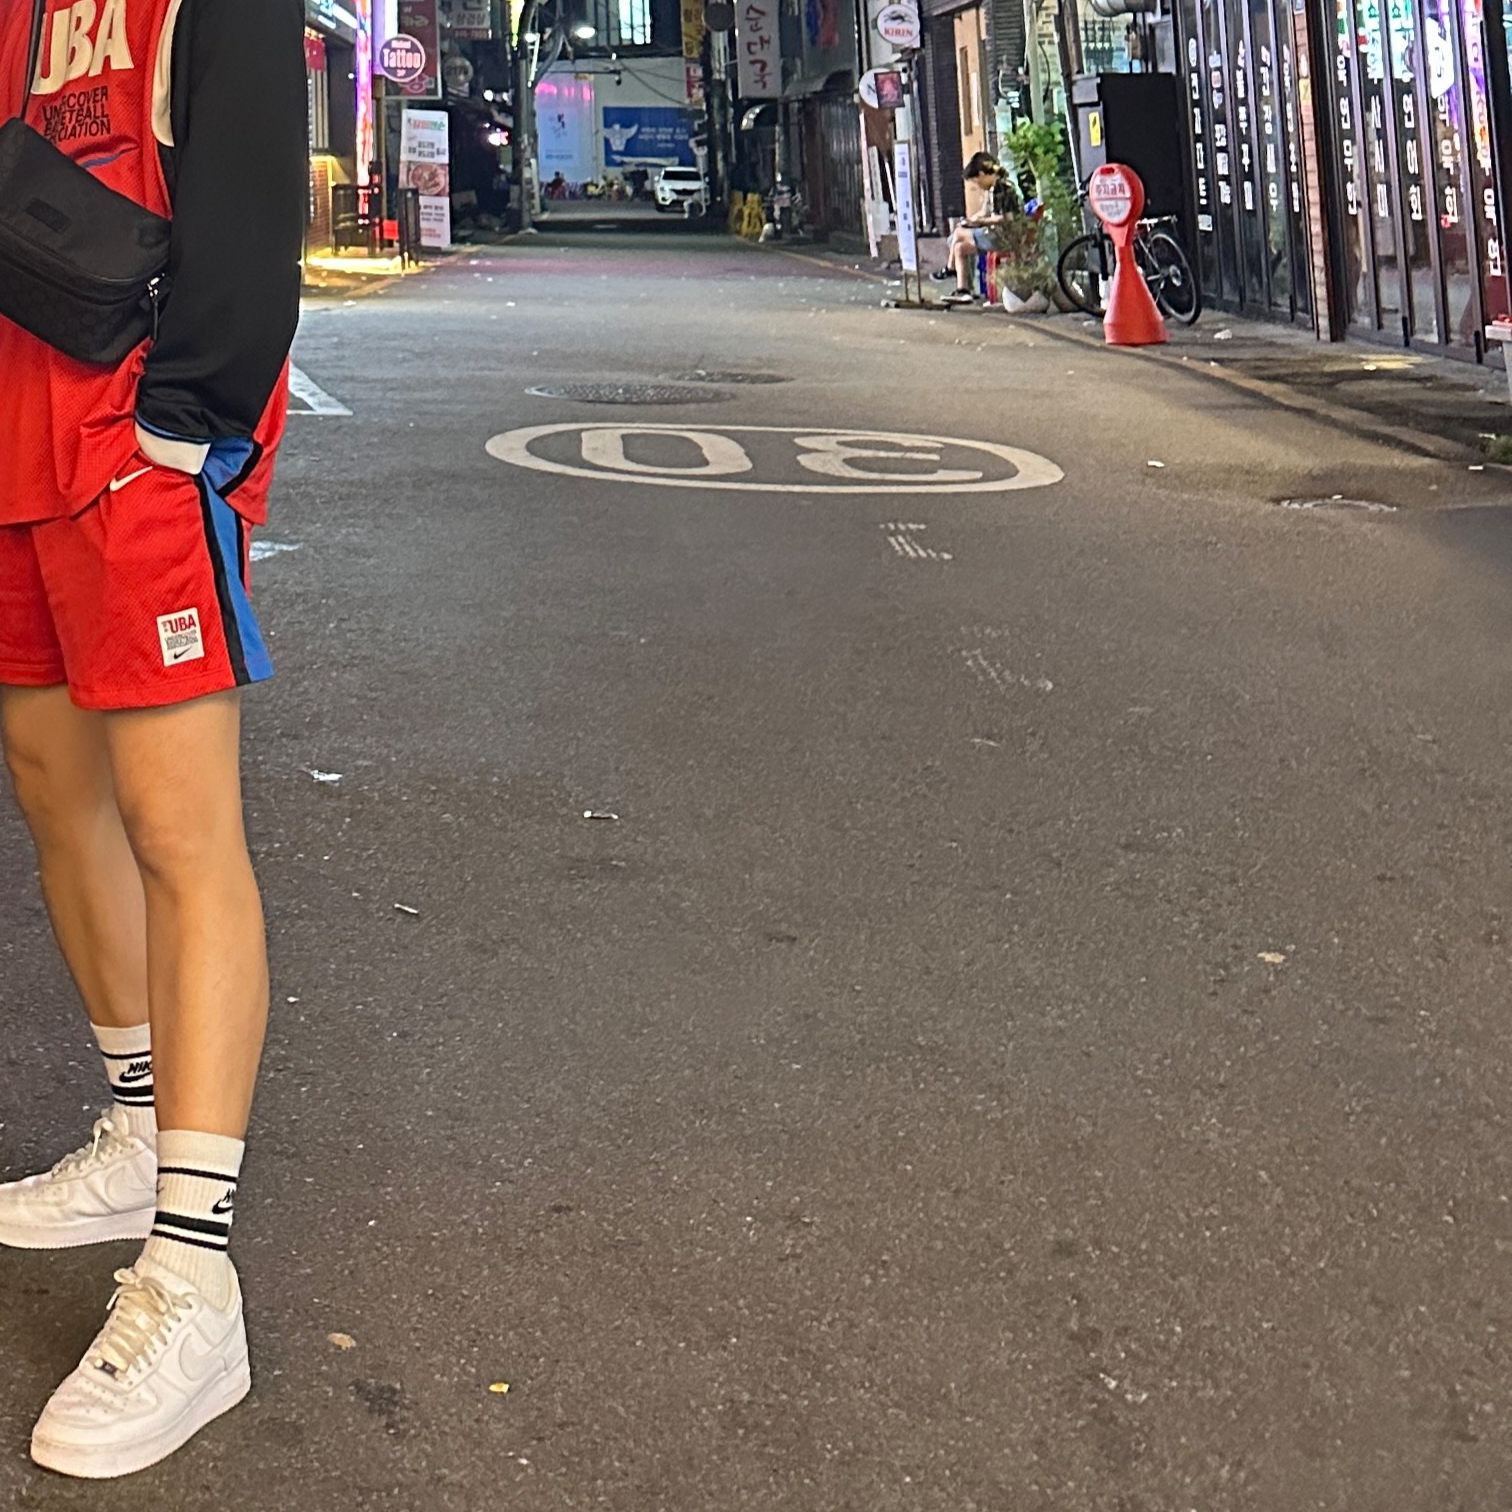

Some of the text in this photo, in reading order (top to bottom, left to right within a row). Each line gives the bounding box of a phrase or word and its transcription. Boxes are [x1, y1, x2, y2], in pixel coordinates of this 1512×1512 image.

[884, 27, 914, 38] KIRIN
[384, 48, 421, 69] Tattoo
[170, 614, 197, 634] UBA
